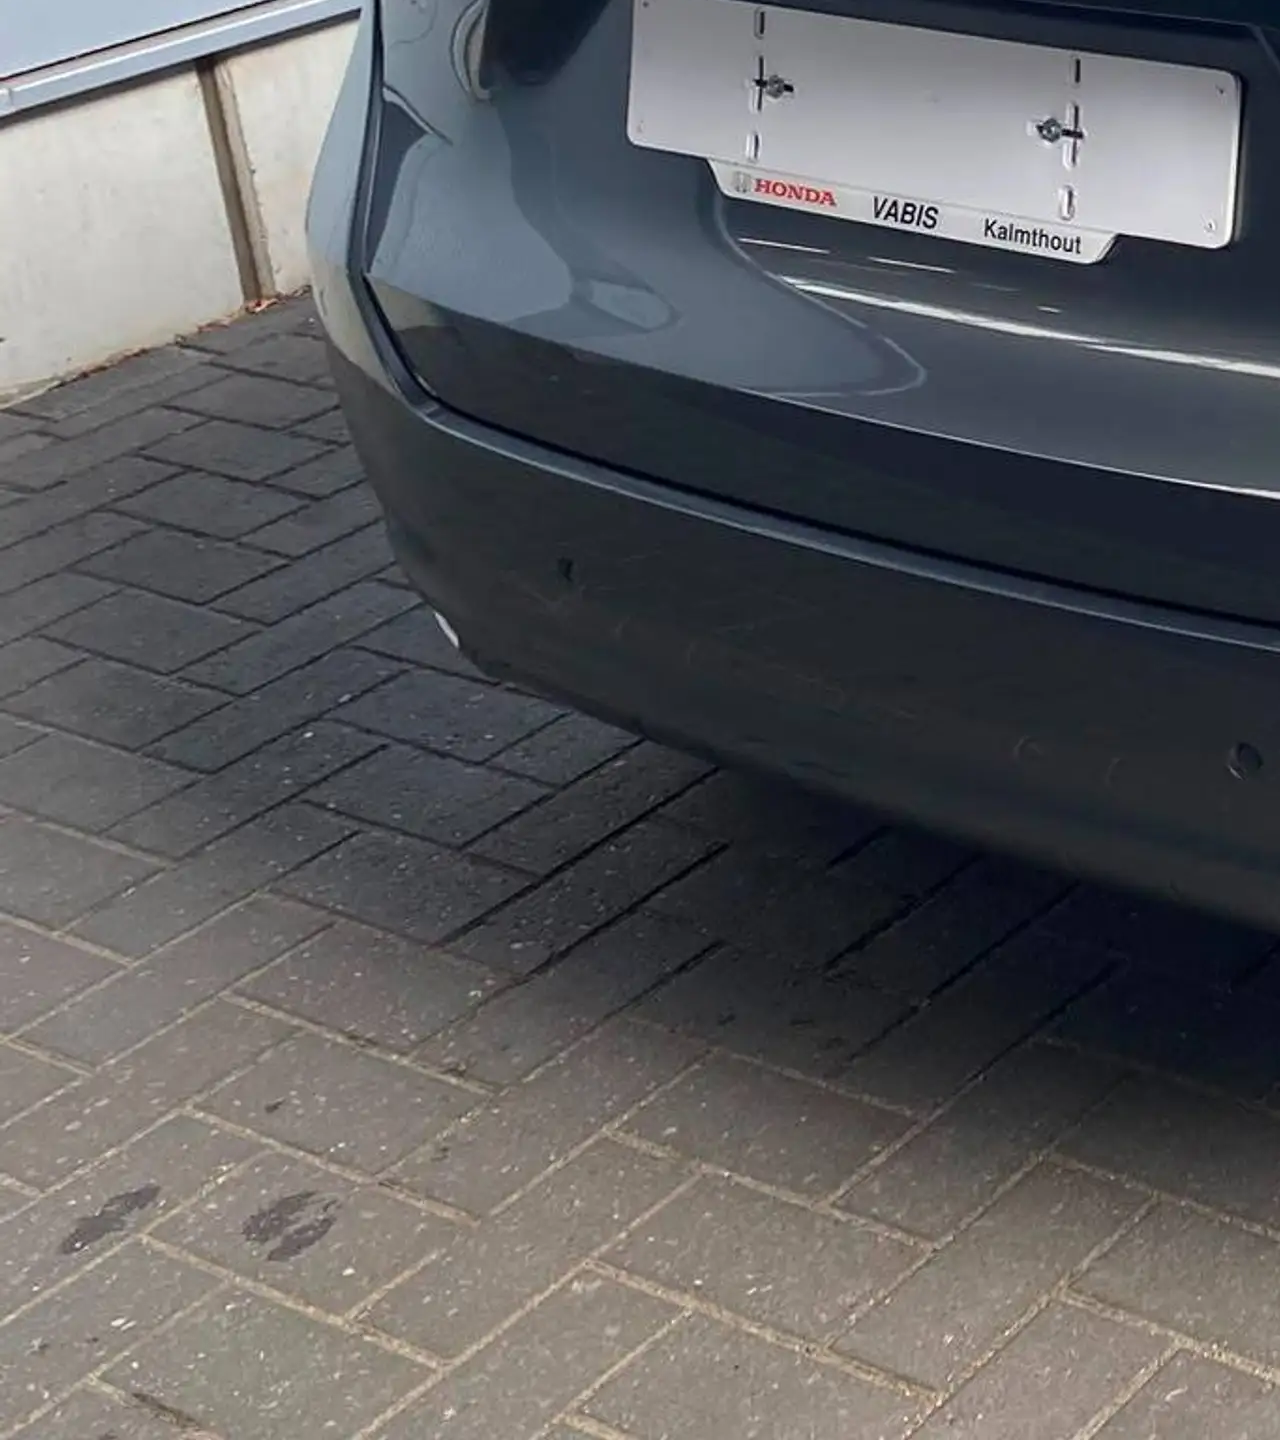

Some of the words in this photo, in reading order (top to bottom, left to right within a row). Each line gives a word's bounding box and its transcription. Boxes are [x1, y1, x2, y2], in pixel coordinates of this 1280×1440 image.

[754, 178, 837, 207] HONDA
[871, 195, 940, 229] VABIS
[984, 217, 1082, 254] Kalmthout
